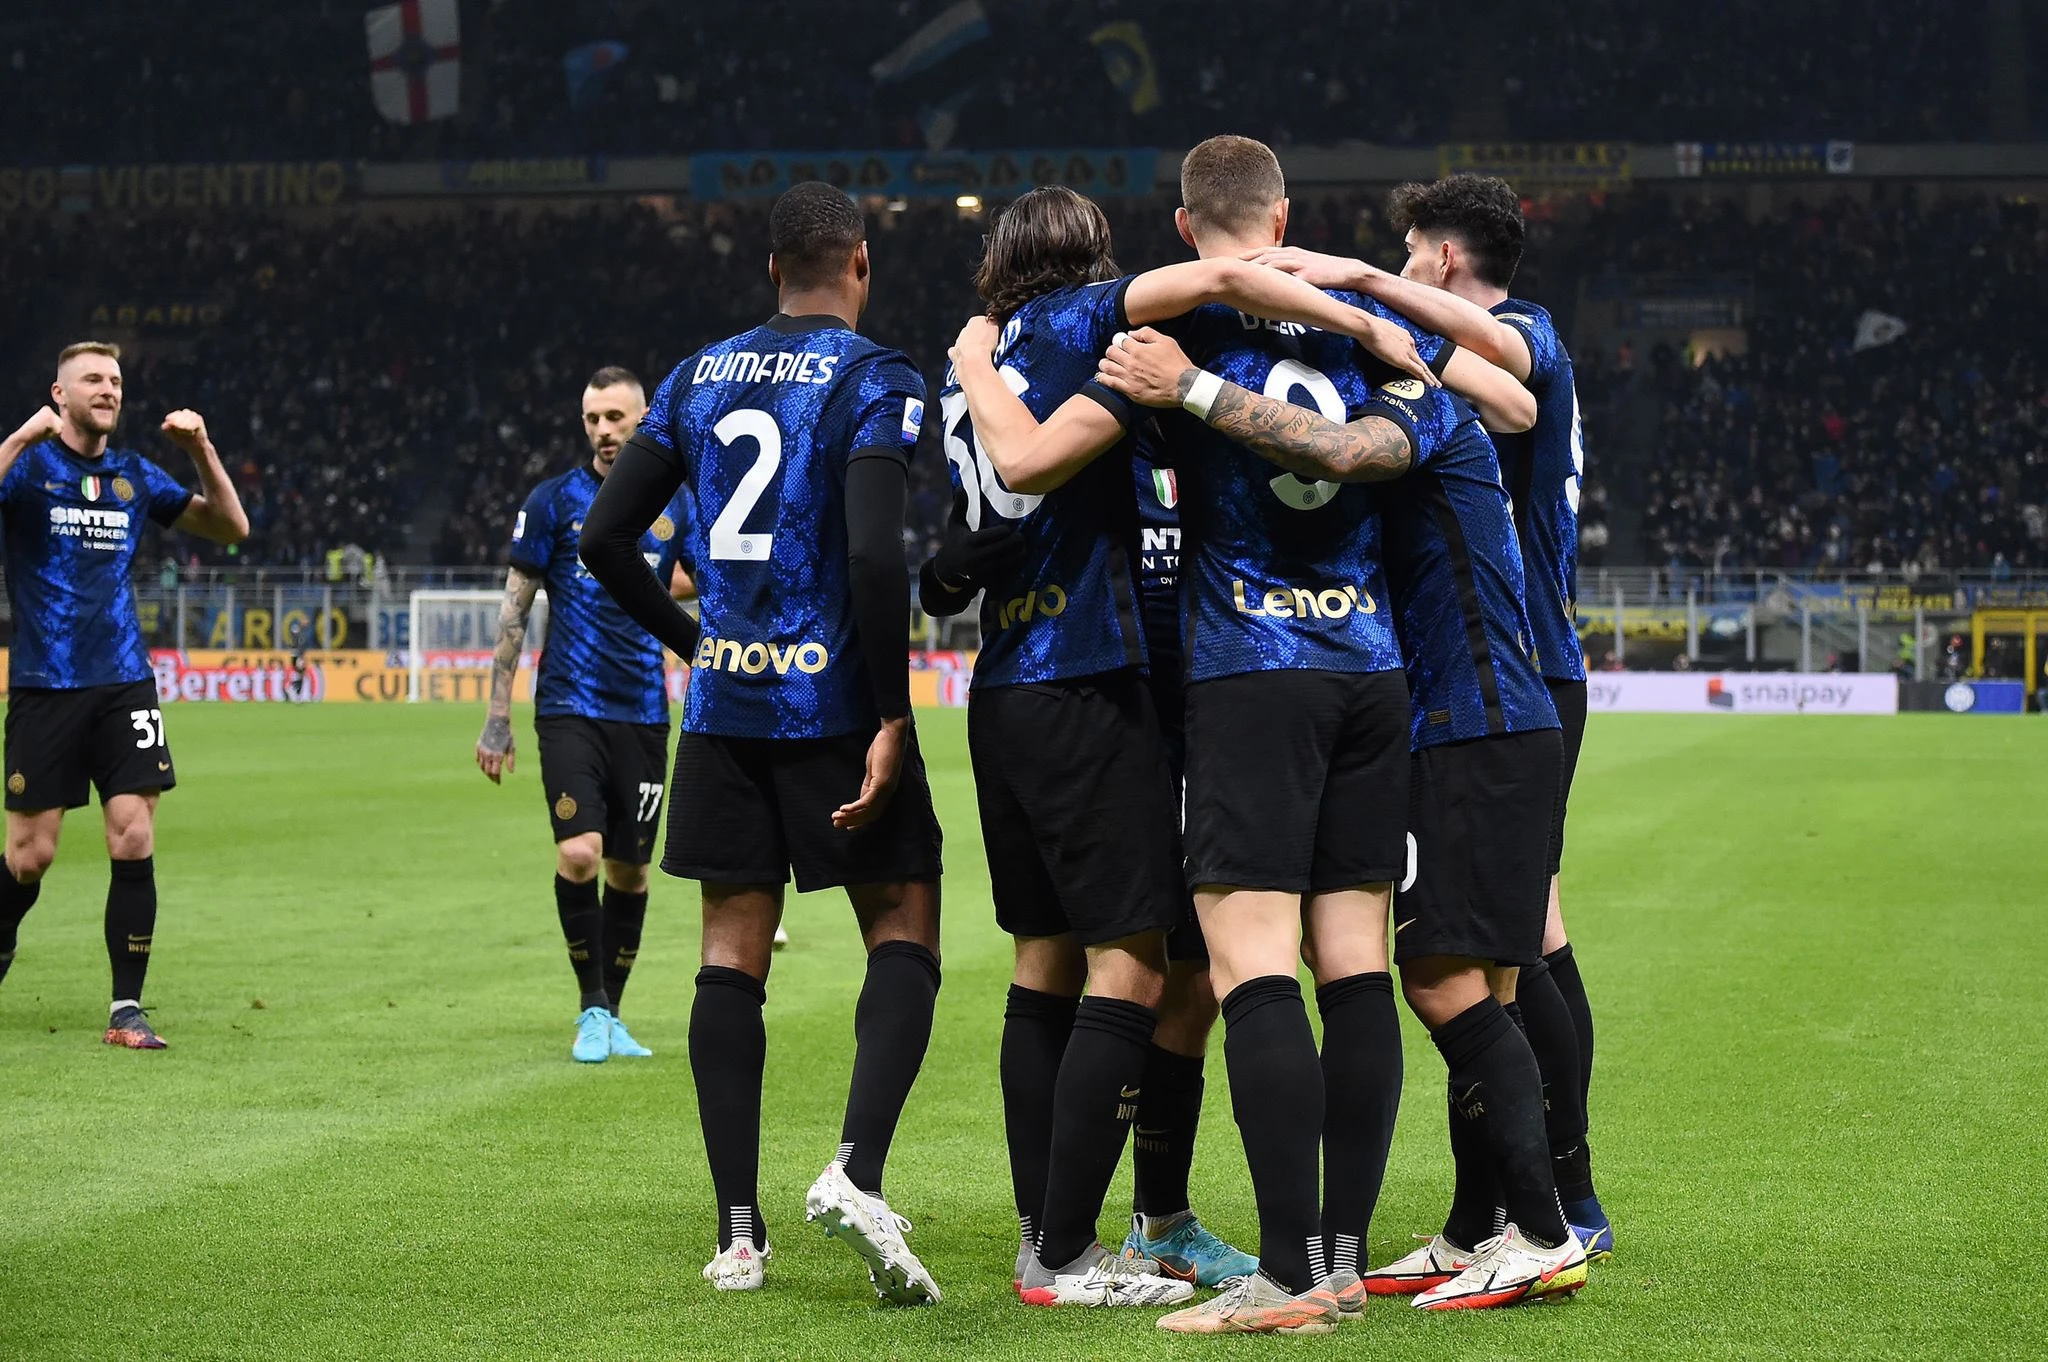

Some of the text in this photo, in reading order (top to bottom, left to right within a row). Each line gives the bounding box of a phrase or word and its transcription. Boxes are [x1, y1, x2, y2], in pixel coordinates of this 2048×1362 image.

[97, 161, 345, 210] VICENTINO
[692, 351, 839, 384] DUMFRIES
[710, 408, 781, 561] 2
[51, 526, 128, 540] FAN TOKEN
[691, 636, 828, 674] enovo
[156, 655, 318, 702] Beretta
[356, 673, 489, 701] CUETT
[1741, 682, 1852, 707] snaipay
[637, 782, 663, 822] 77
